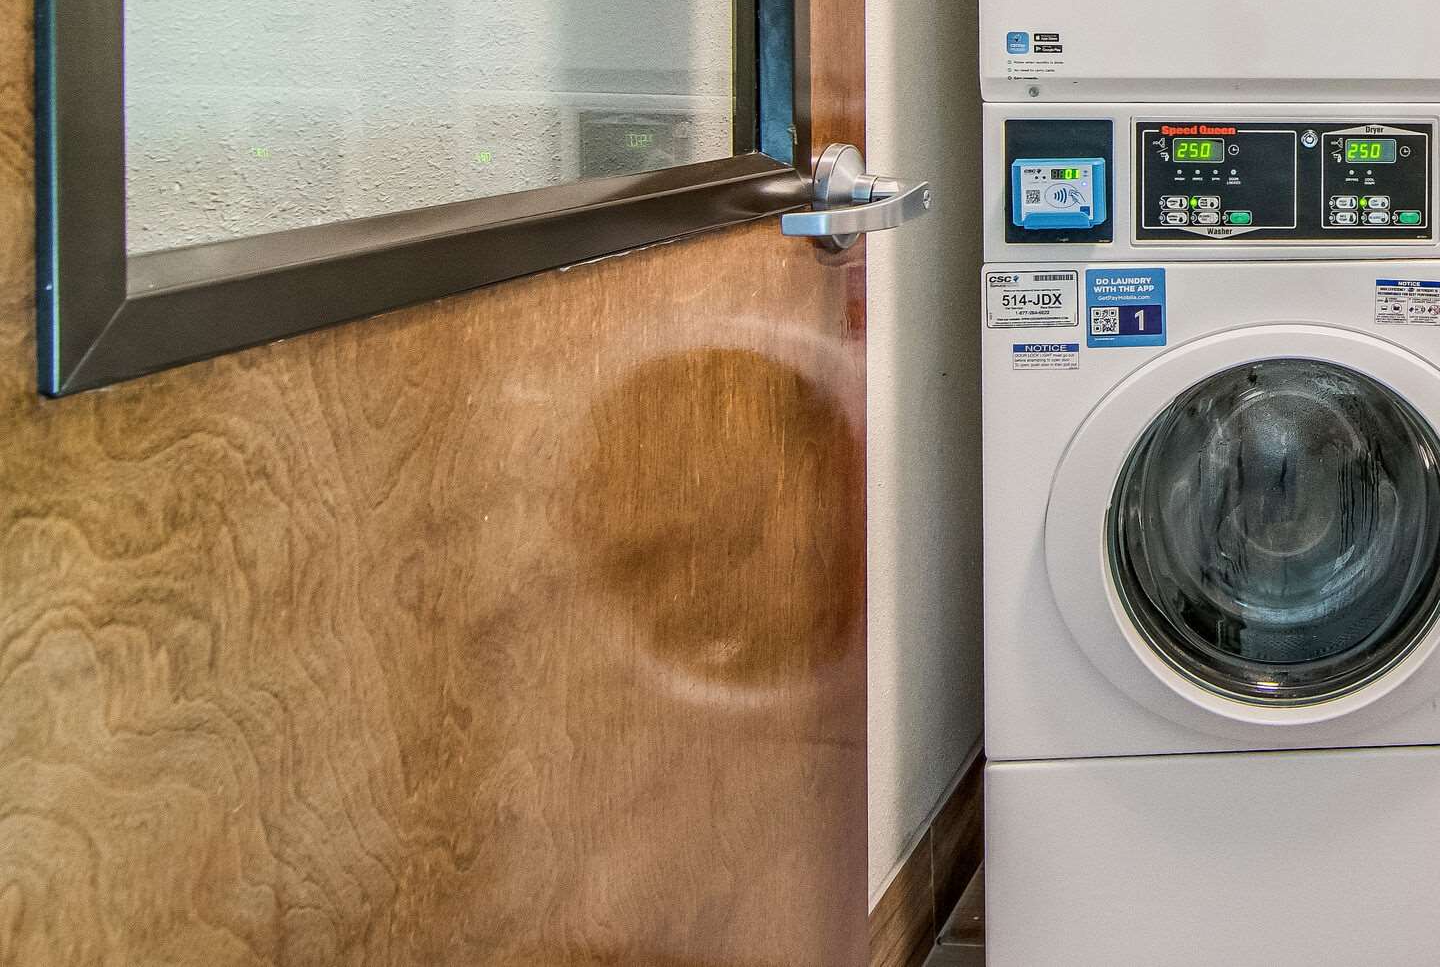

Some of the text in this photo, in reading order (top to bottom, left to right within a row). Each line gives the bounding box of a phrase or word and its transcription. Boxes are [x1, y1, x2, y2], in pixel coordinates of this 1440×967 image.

[1161, 125, 1236, 137] Speed Queen
[1365, 126, 1384, 134] Dryer
[1177, 142, 1212, 157] 250
[1347, 144, 1381, 158] 250
[989, 275, 1012, 283] CSC
[1111, 277, 1152, 285] LAUNDRY
[1118, 285, 1135, 293] THE
[1137, 284, 1154, 292] APP
[1002, 293, 1062, 307] 514-JDX
[1134, 309, 1144, 331] 1
[1025, 344, 1068, 352] NOTICE
